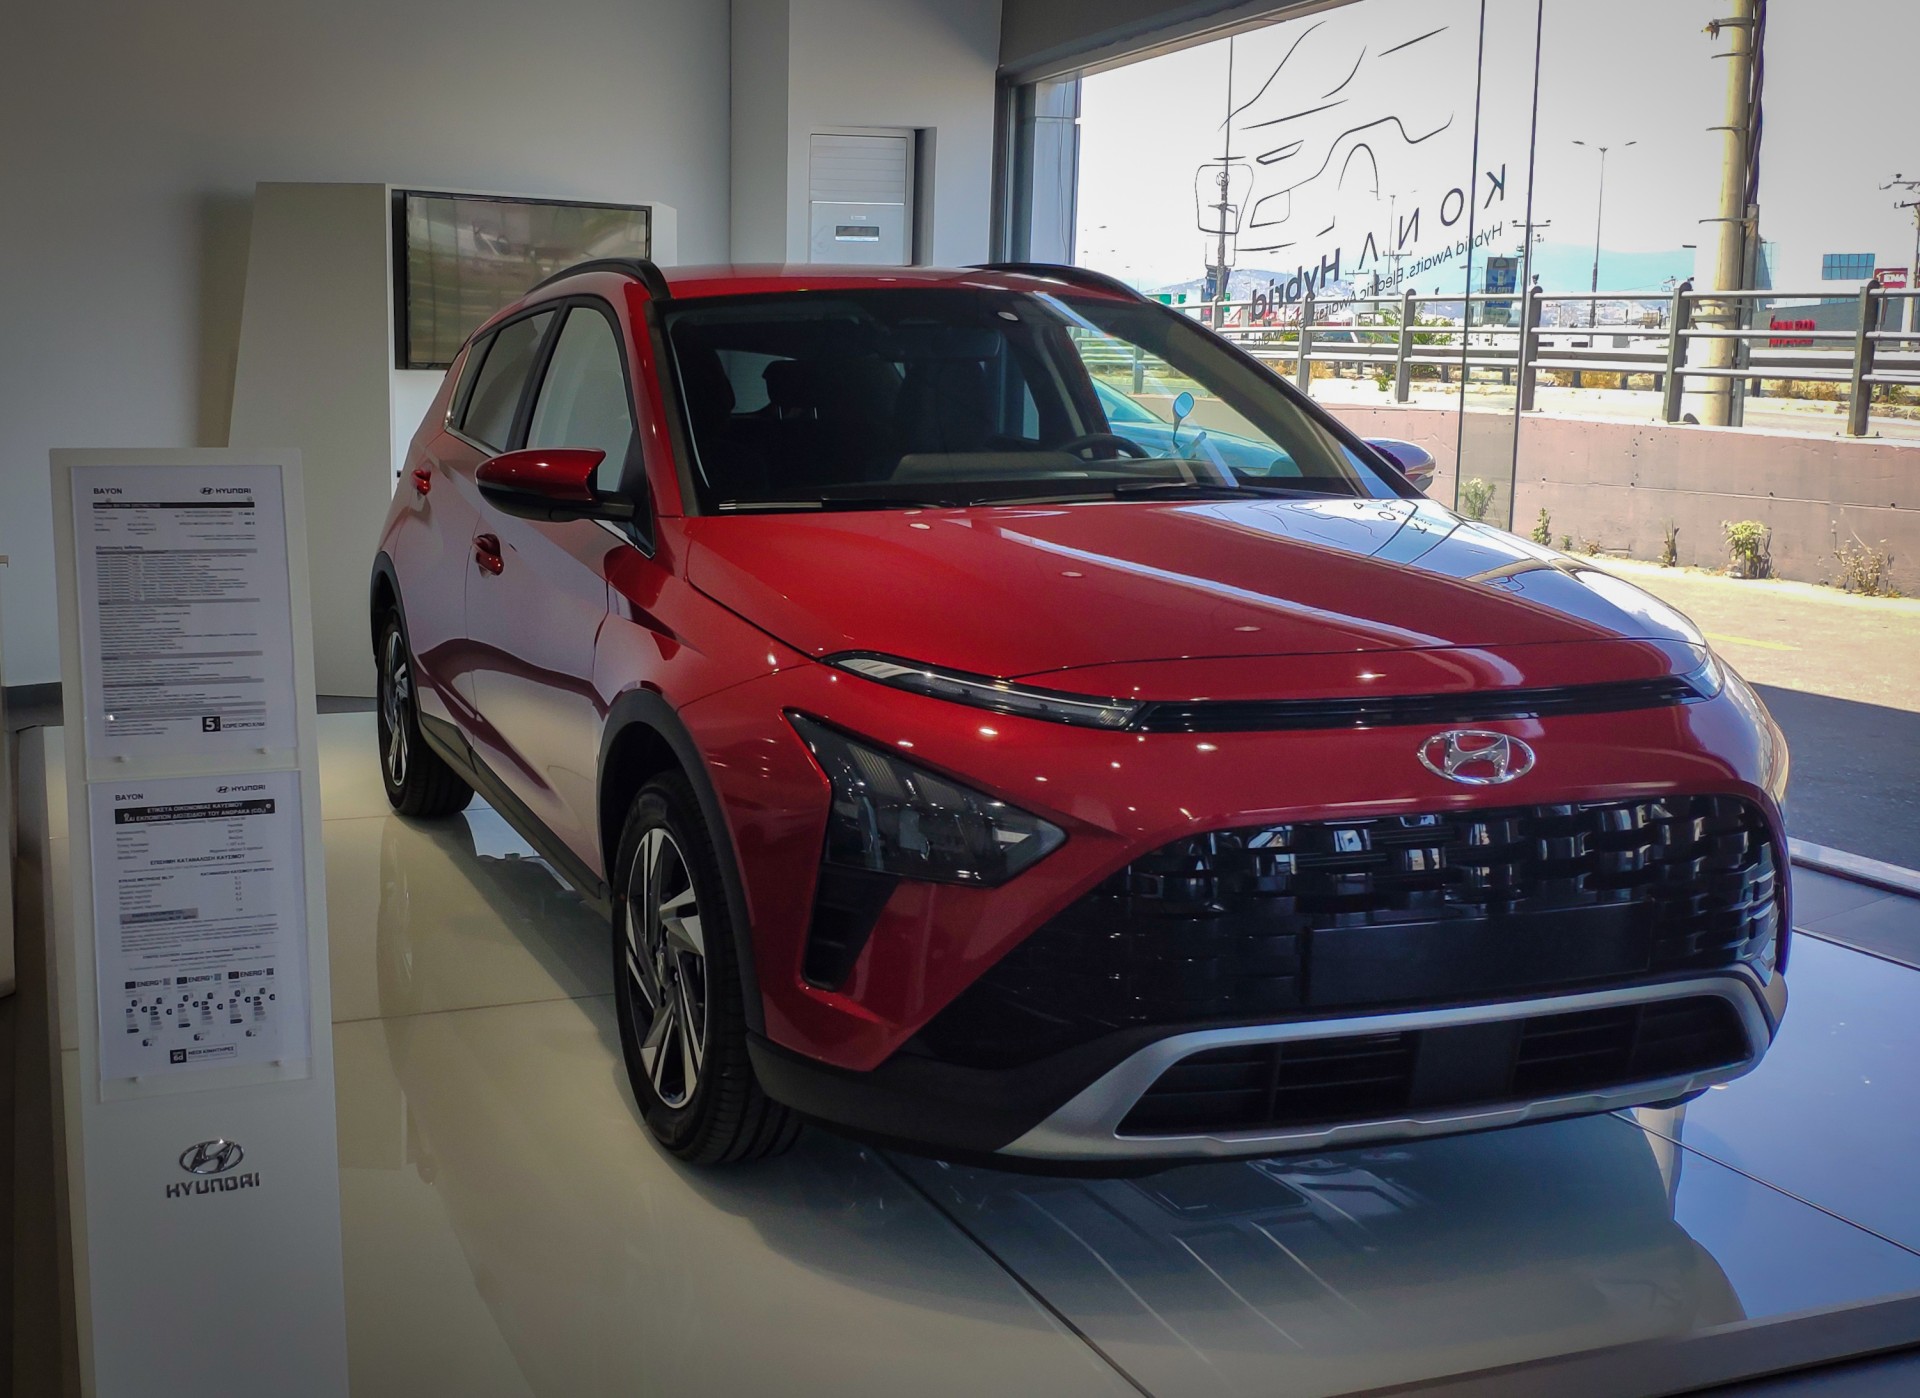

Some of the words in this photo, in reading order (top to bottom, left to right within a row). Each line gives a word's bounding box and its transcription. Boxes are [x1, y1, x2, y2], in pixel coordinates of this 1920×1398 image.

[93, 487, 123, 495] BAYON
[205, 717, 215, 731] 5
[231, 784, 266, 792] HYUNDAI
[115, 793, 144, 802] BAYON
[166, 1171, 261, 1199] HYUNDAI
